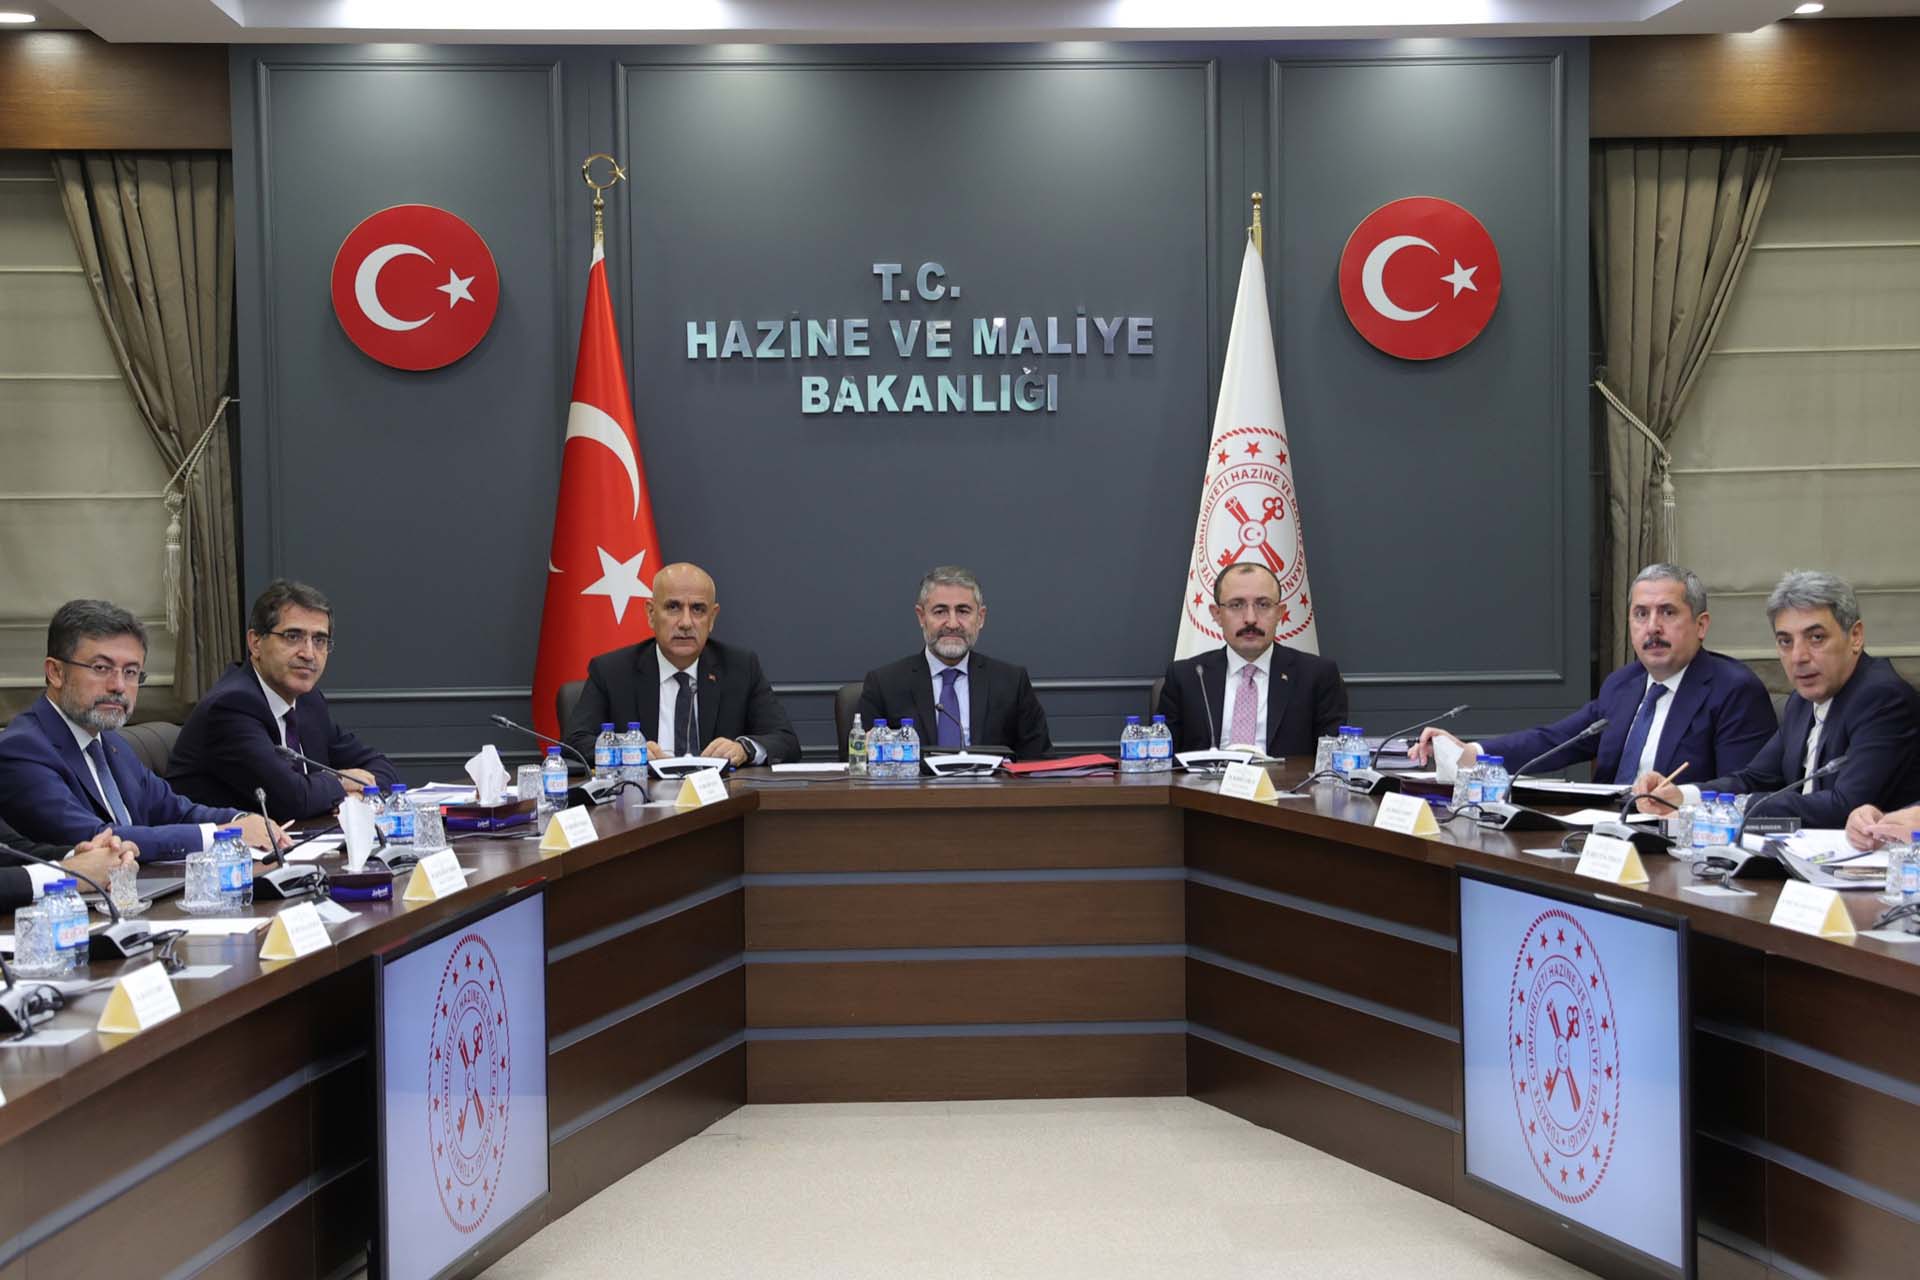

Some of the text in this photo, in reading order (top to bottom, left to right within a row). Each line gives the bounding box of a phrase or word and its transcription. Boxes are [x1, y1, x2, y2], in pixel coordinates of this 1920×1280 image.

[873, 261, 961, 302] T.C.
[686, 304, 1154, 360] HAZİNE VE MALİYE
[801, 367, 1058, 414] BAKANLIĞI
[1230, 468, 1281, 485] HAZİNE
[1281, 480, 1292, 497] VE
